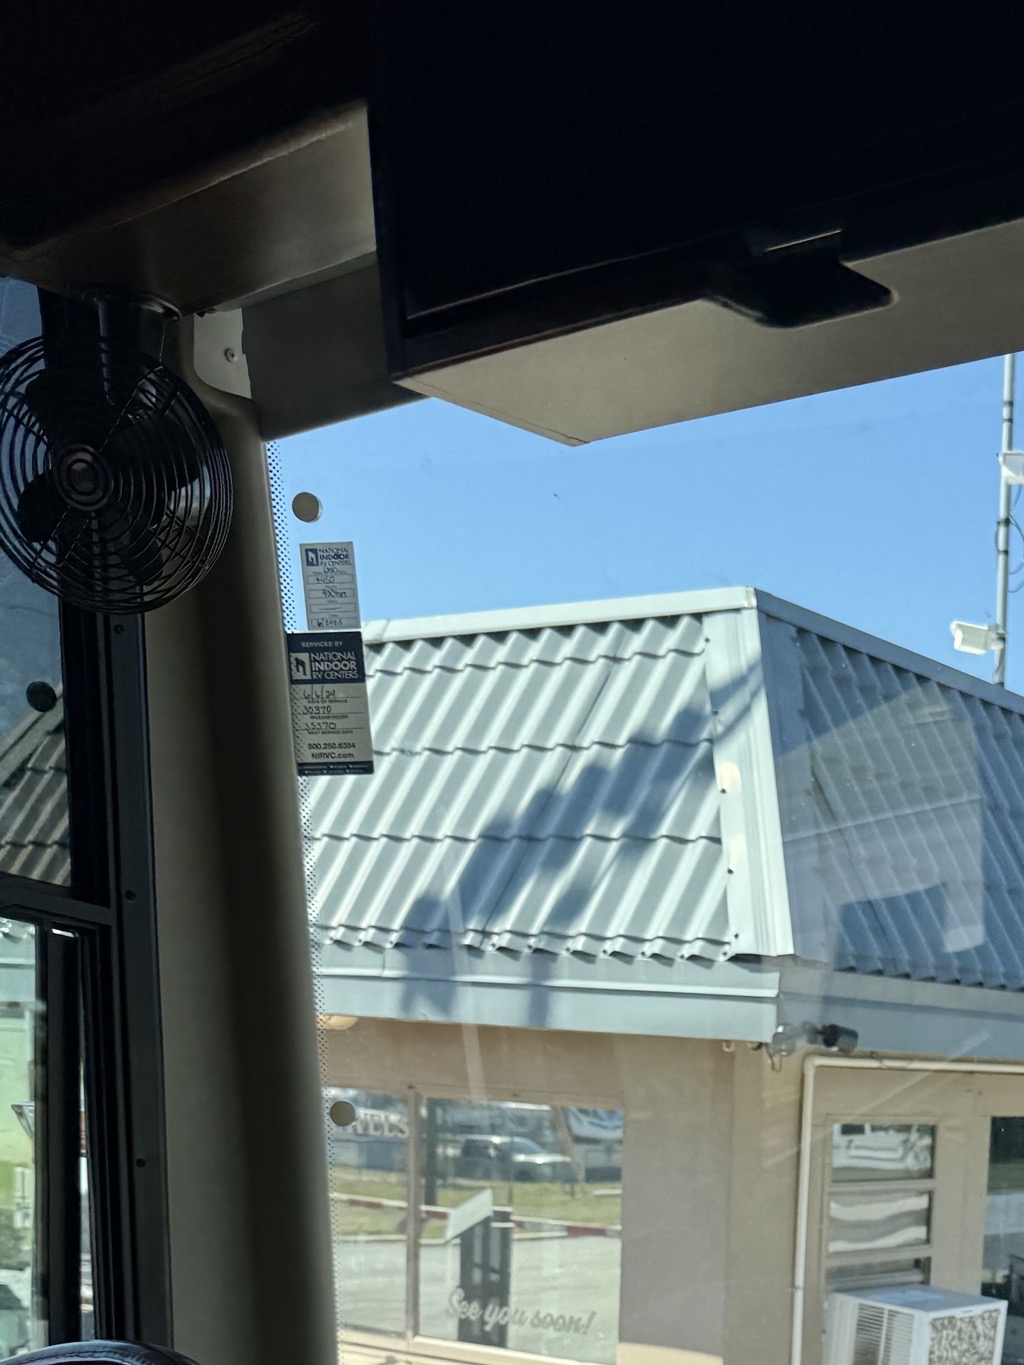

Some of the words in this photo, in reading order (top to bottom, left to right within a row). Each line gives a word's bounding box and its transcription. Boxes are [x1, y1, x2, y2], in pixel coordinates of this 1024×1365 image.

[319, 553, 350, 561] INDOOR
[310, 651, 357, 661] NATIONAL
[312, 660, 357, 671] INDOOR
[312, 671, 324, 680] RV
[324, 670, 359, 680] CENTERS
[311, 752, 355, 760] NIRVC.com
[448, 1287, 483, 1321] See
[483, 1303, 528, 1332] you
[529, 1310, 597, 1336] soon!
